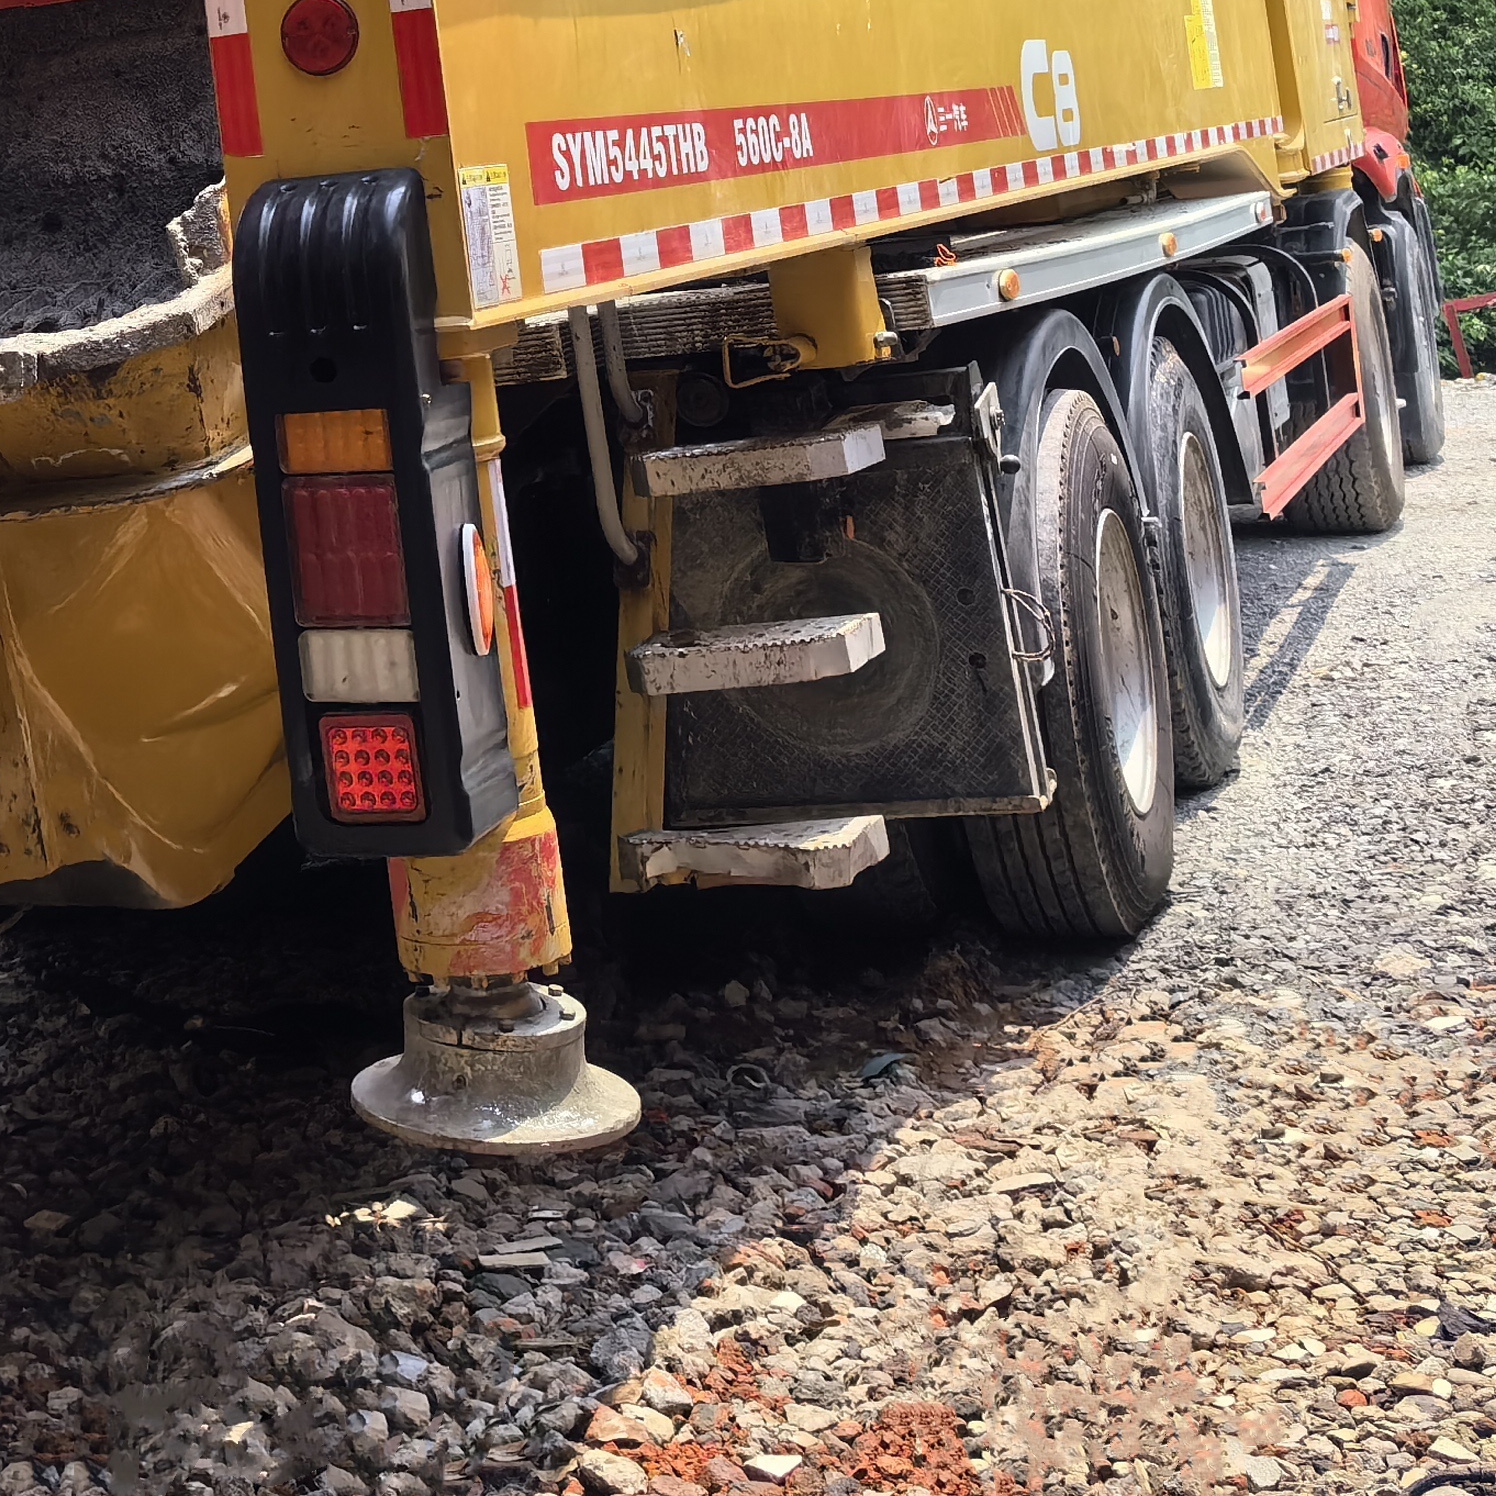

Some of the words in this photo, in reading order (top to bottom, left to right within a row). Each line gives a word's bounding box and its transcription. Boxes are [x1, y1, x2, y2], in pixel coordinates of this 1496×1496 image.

[1020, 39, 1081, 152] C8
[551, 122, 710, 191] SYM5445THB
[733, 112, 814, 167] 560C-8A
